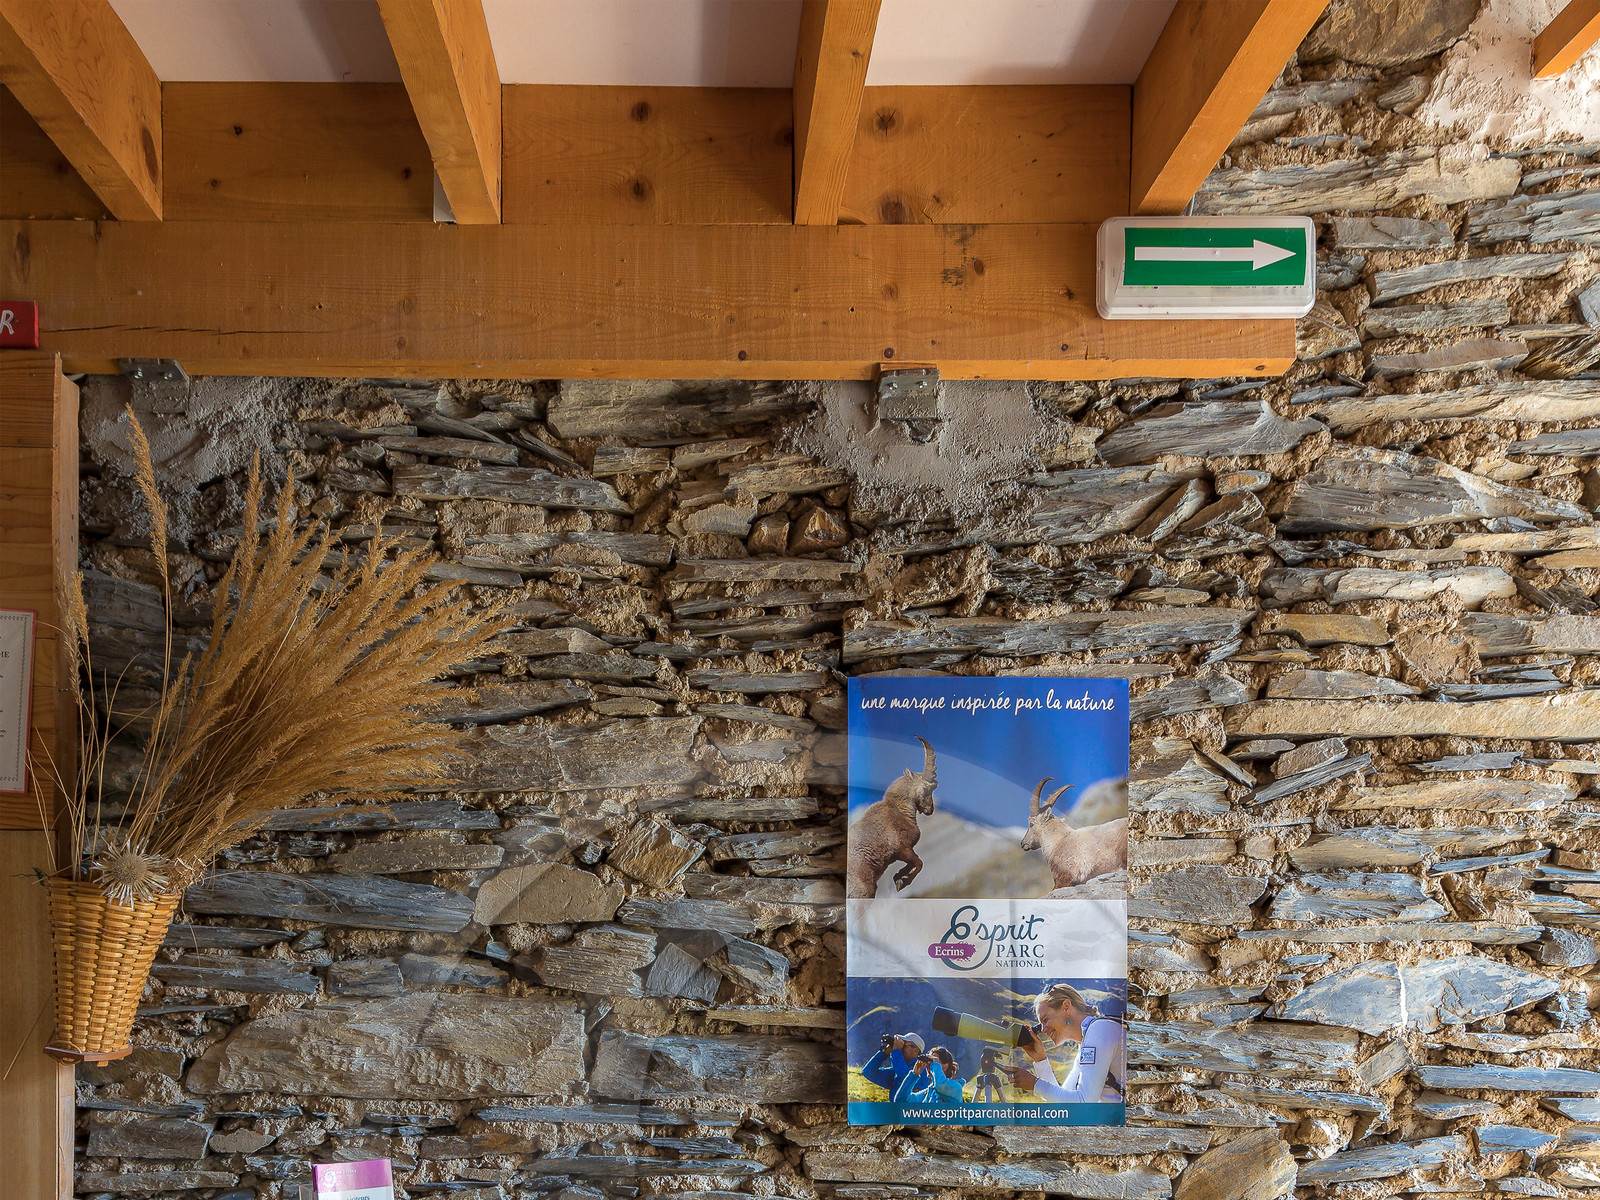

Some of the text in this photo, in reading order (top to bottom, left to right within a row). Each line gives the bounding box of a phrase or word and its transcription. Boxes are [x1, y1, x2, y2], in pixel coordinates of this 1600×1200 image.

[861, 689, 1115, 715] une marque inspirée par la nature
[940, 905, 1045, 971] Esprit
[934, 945, 965, 956] Ecrins
[996, 944, 1045, 958] PARC
[995, 960, 1045, 968] NATIONAL
[902, 1106, 1069, 1121] www.espritparcnational.com
